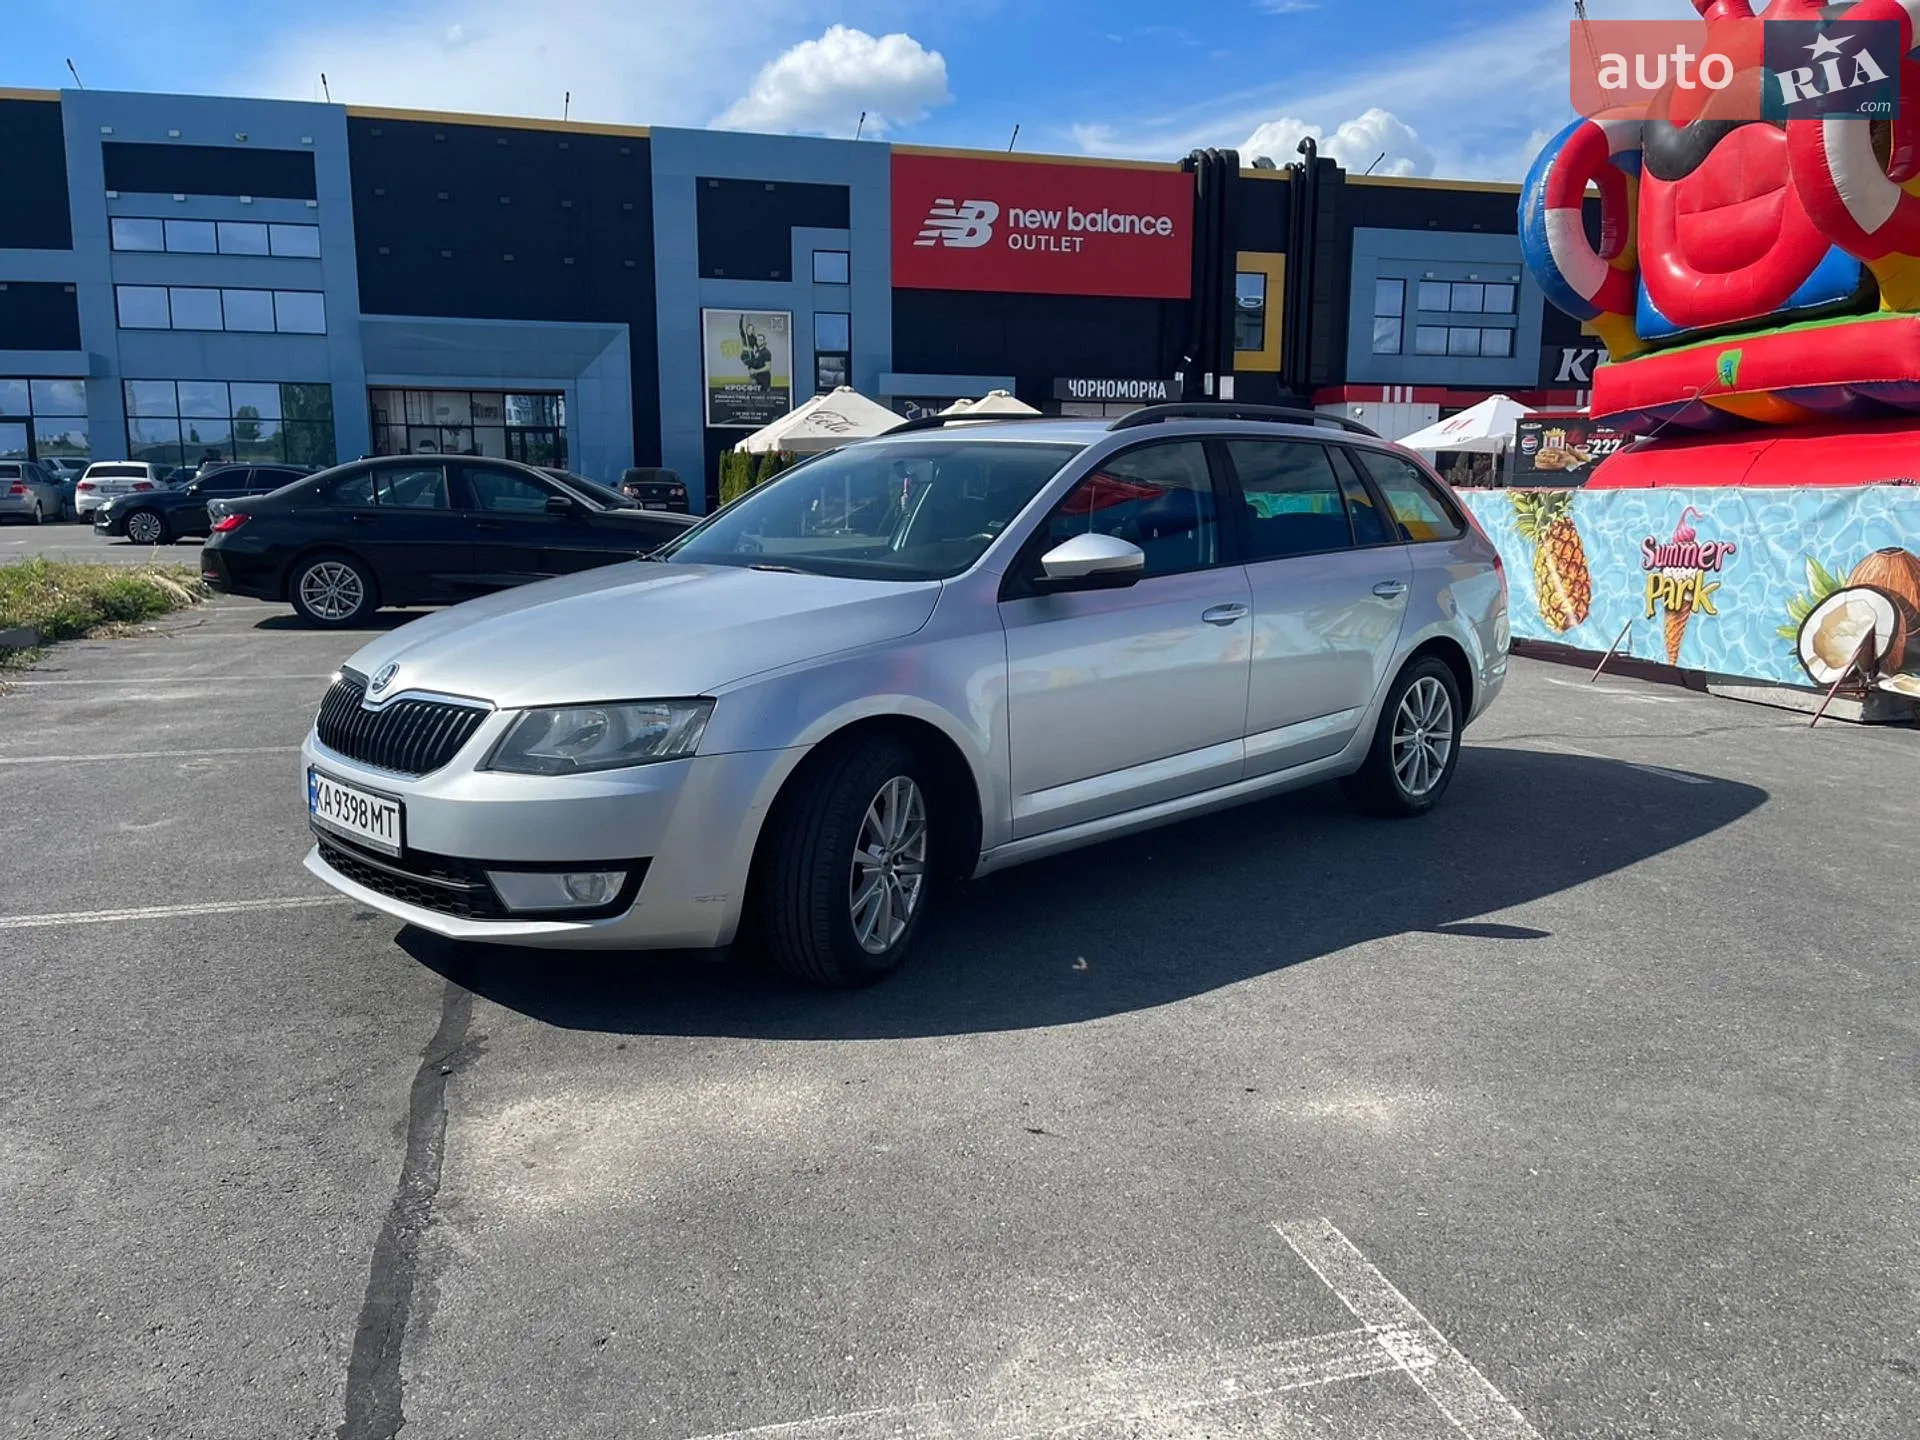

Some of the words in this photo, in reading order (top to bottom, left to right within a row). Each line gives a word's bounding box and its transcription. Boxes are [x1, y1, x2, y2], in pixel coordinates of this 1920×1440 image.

[1008, 207, 1062, 230] new
[1067, 206, 1173, 236] balance
[1008, 233, 1084, 252] OUTLET
[1067, 379, 1167, 399] ЧОРНОМОРКА
[1641, 535, 1737, 572] Summer
[1645, 569, 1721, 619] Park
